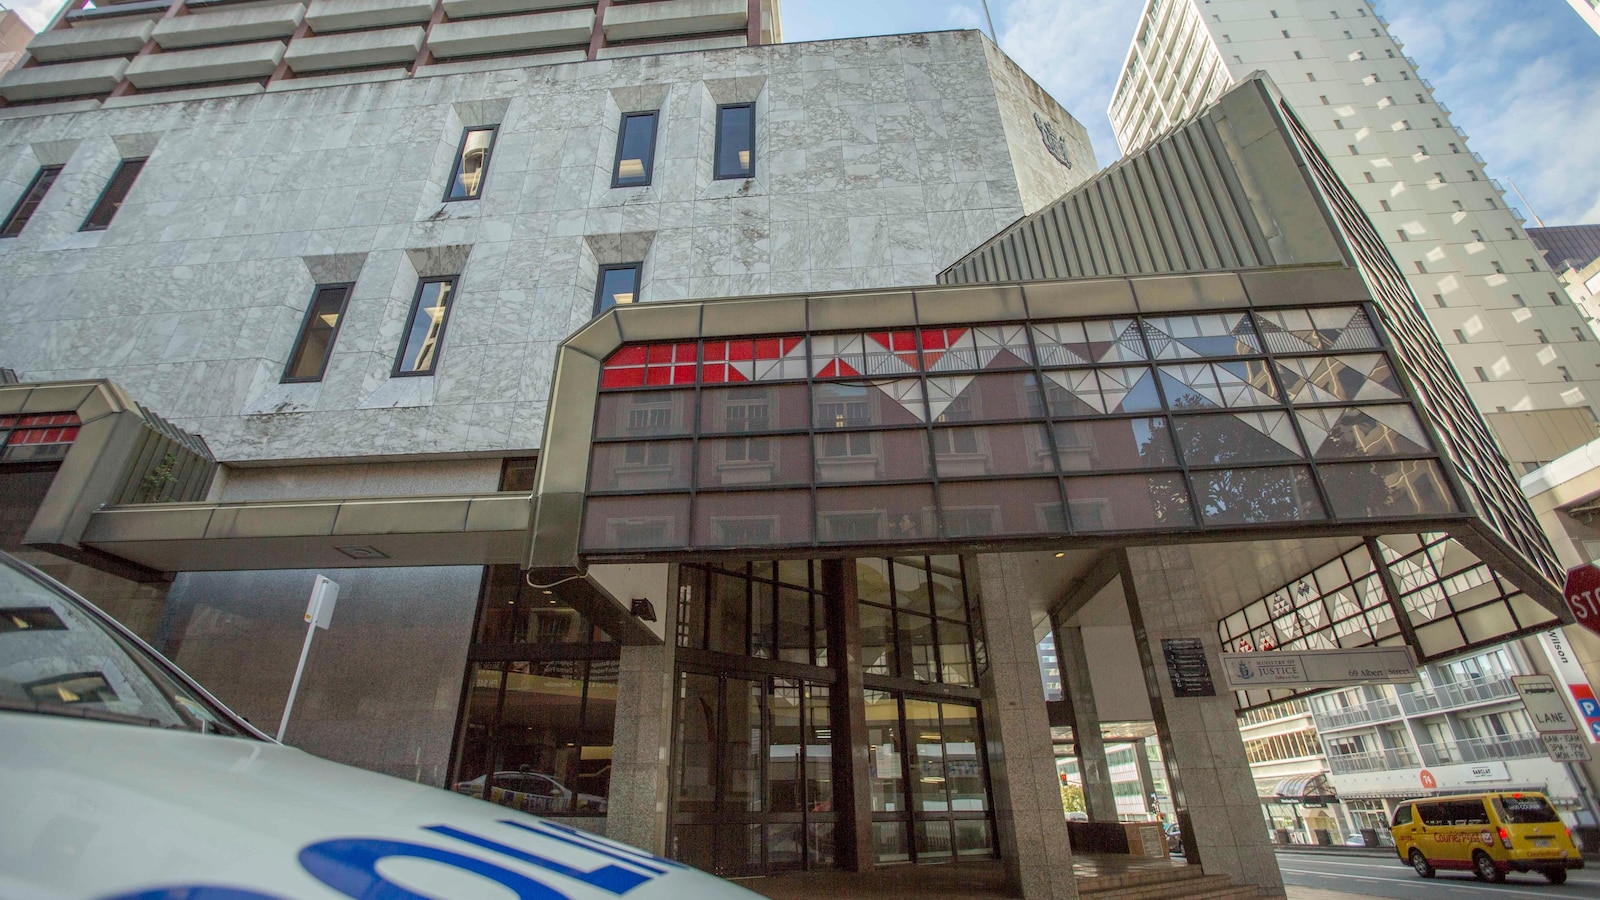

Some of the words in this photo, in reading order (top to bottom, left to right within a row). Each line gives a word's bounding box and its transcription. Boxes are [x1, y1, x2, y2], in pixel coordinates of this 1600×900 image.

[1547, 628, 1569, 664] Wilson
[1258, 666, 1299, 677] JUSTICE
[1349, 669, 1359, 677] 69
[1535, 712, 1567, 723] LANE
[1434, 831, 1480, 844] CourierPost
